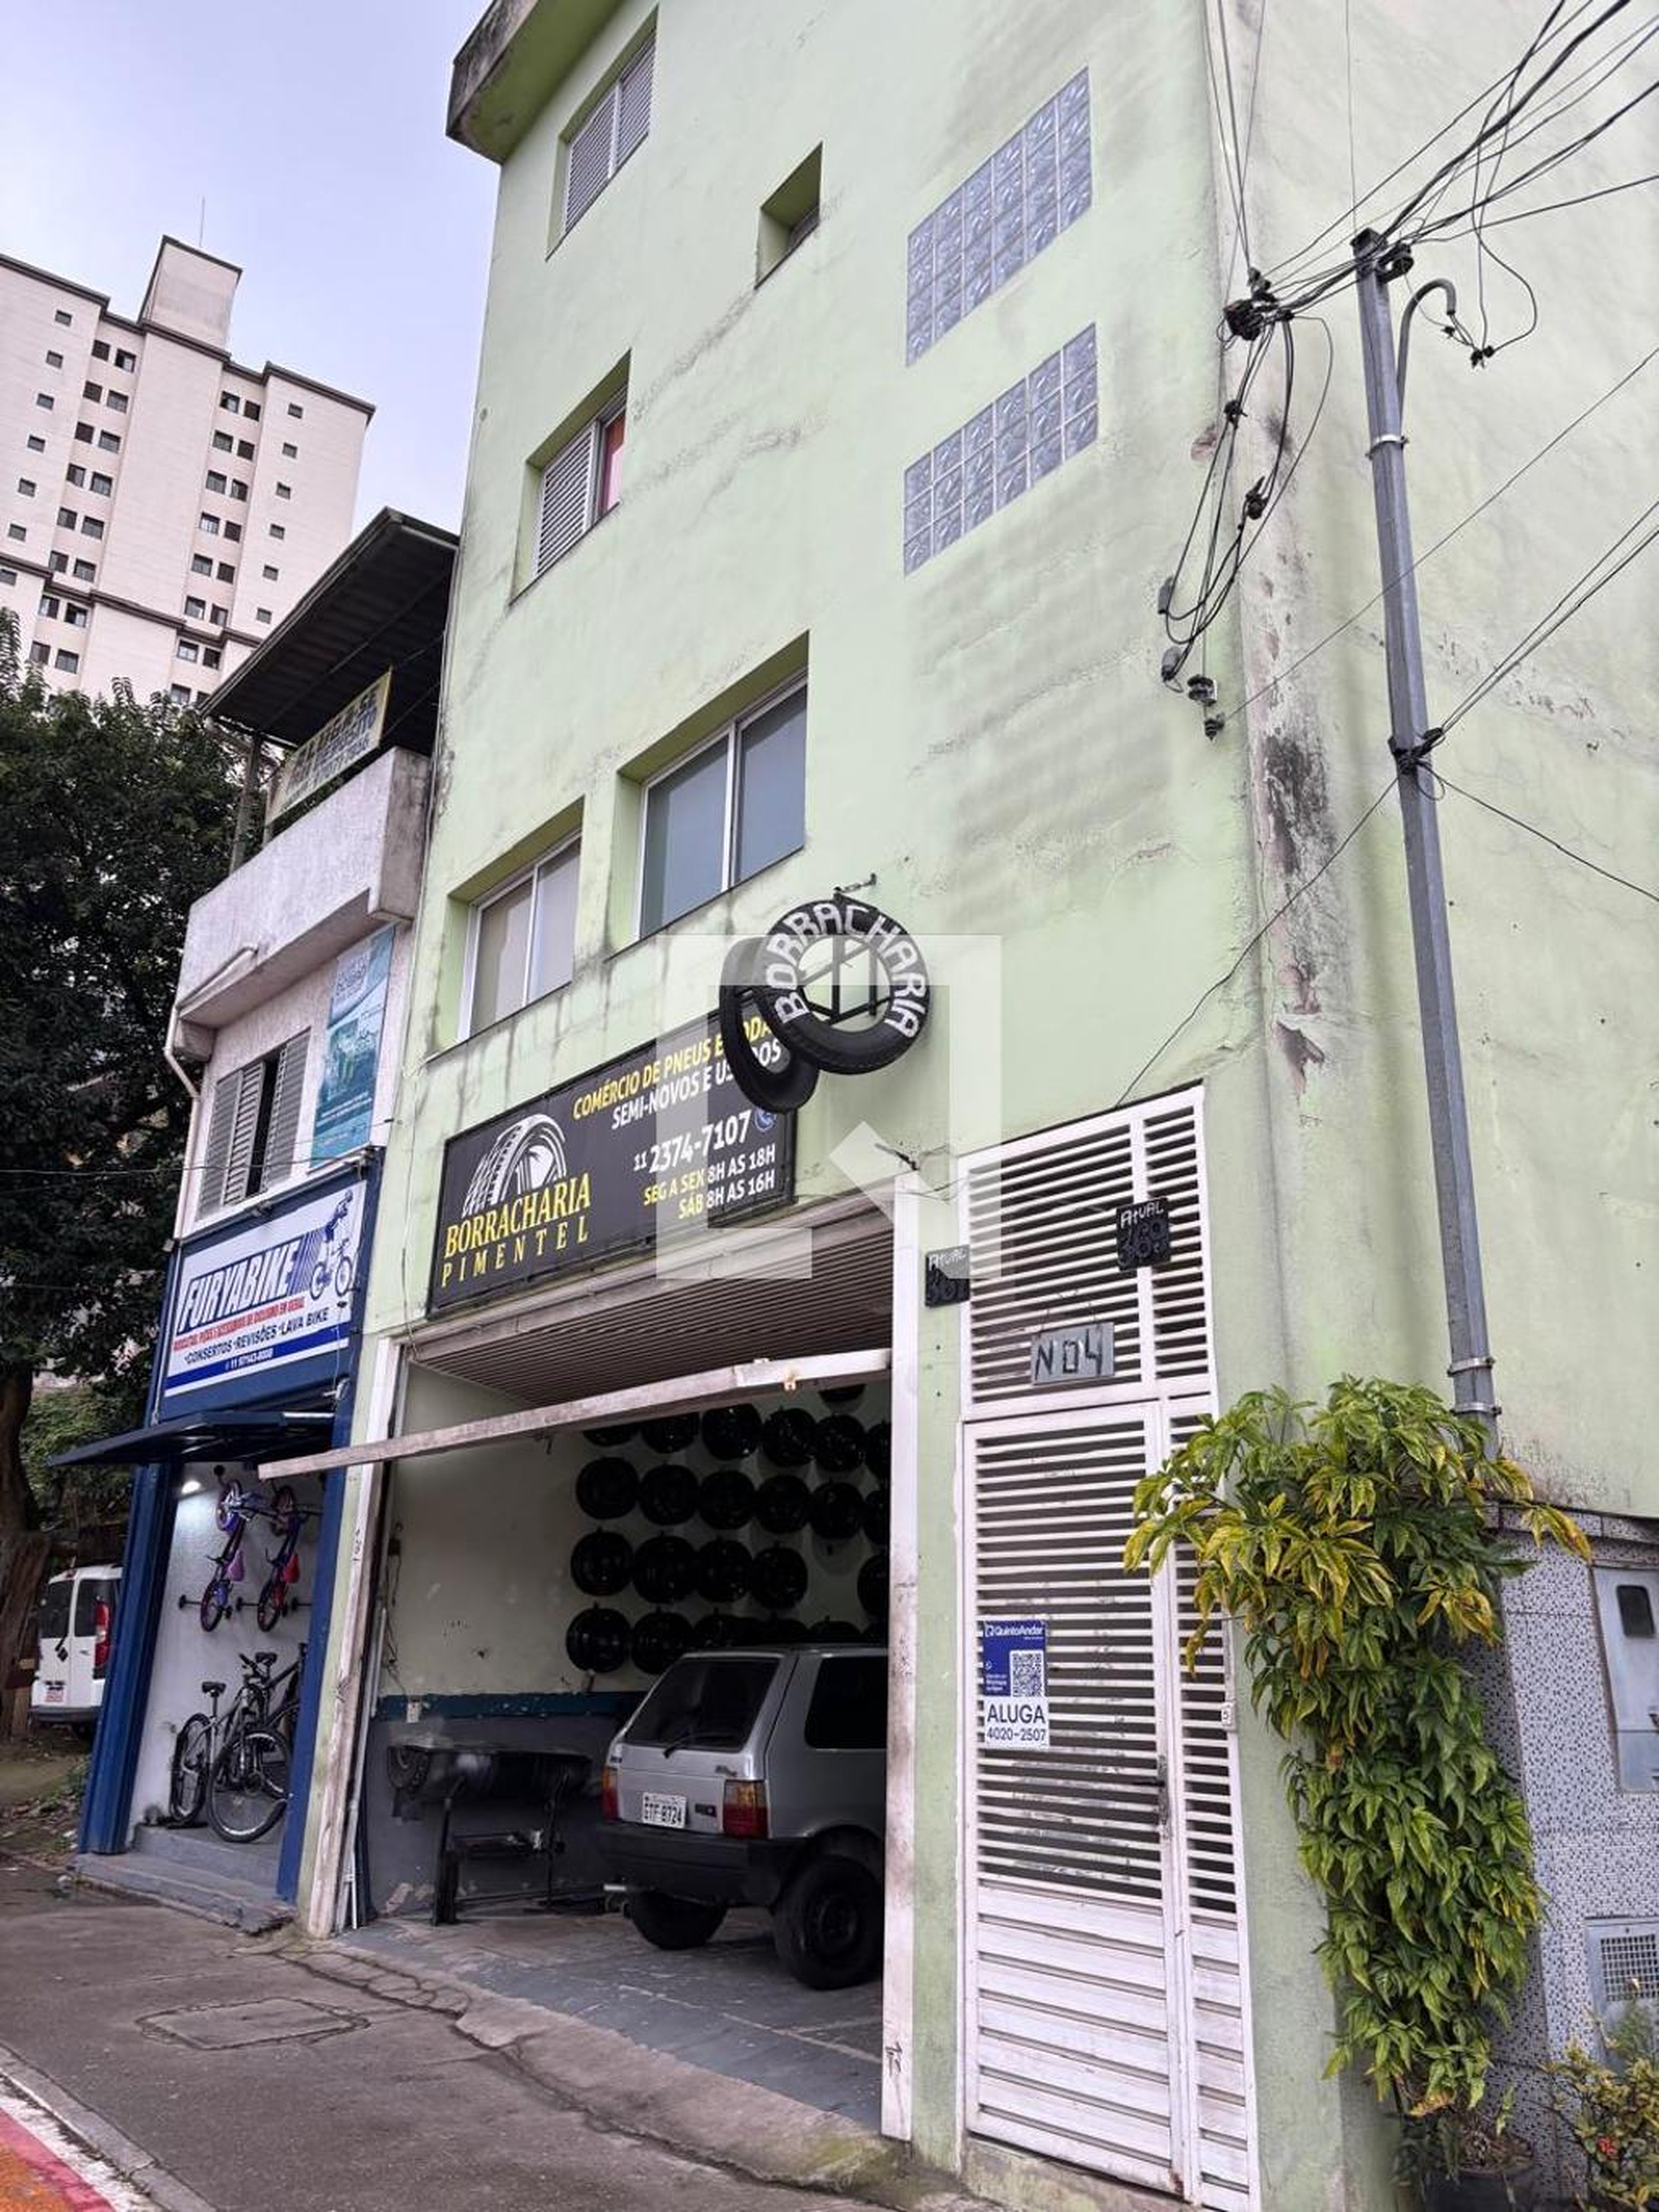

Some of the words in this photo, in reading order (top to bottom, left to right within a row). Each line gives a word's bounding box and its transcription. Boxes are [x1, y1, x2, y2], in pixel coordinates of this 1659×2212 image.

[766, 904, 928, 1038] BORRACHARIA
[573, 1067, 641, 1120] COMÉRCIO
[642, 1061, 661, 1089] DE
[663, 1039, 711, 1079] PNEUS
[611, 1072, 700, 1130] SEMI-NOVOS
[703, 1066, 712, 1092] E
[633, 1151, 647, 1171] 11
[649, 1109, 752, 1174] 2374-7107
[644, 1181, 667, 1206] SEG
[669, 1179, 678, 1197] A
[680, 1168, 705, 1194] SEX
[707, 1161, 725, 1183] 8H
[728, 1154, 746, 1178] AS
[749, 1143, 776, 1171] 18H
[706, 1186, 725, 1209] 8H
[727, 1179, 745, 1203] AS
[747, 1169, 775, 1196] 16H
[444, 1173, 591, 1259] BORRACHARIA
[441, 1216, 589, 1288] PIMENTEL
[987, 1704, 1046, 1724] ALUGA
[987, 1727, 1046, 1741] 4020-2507
